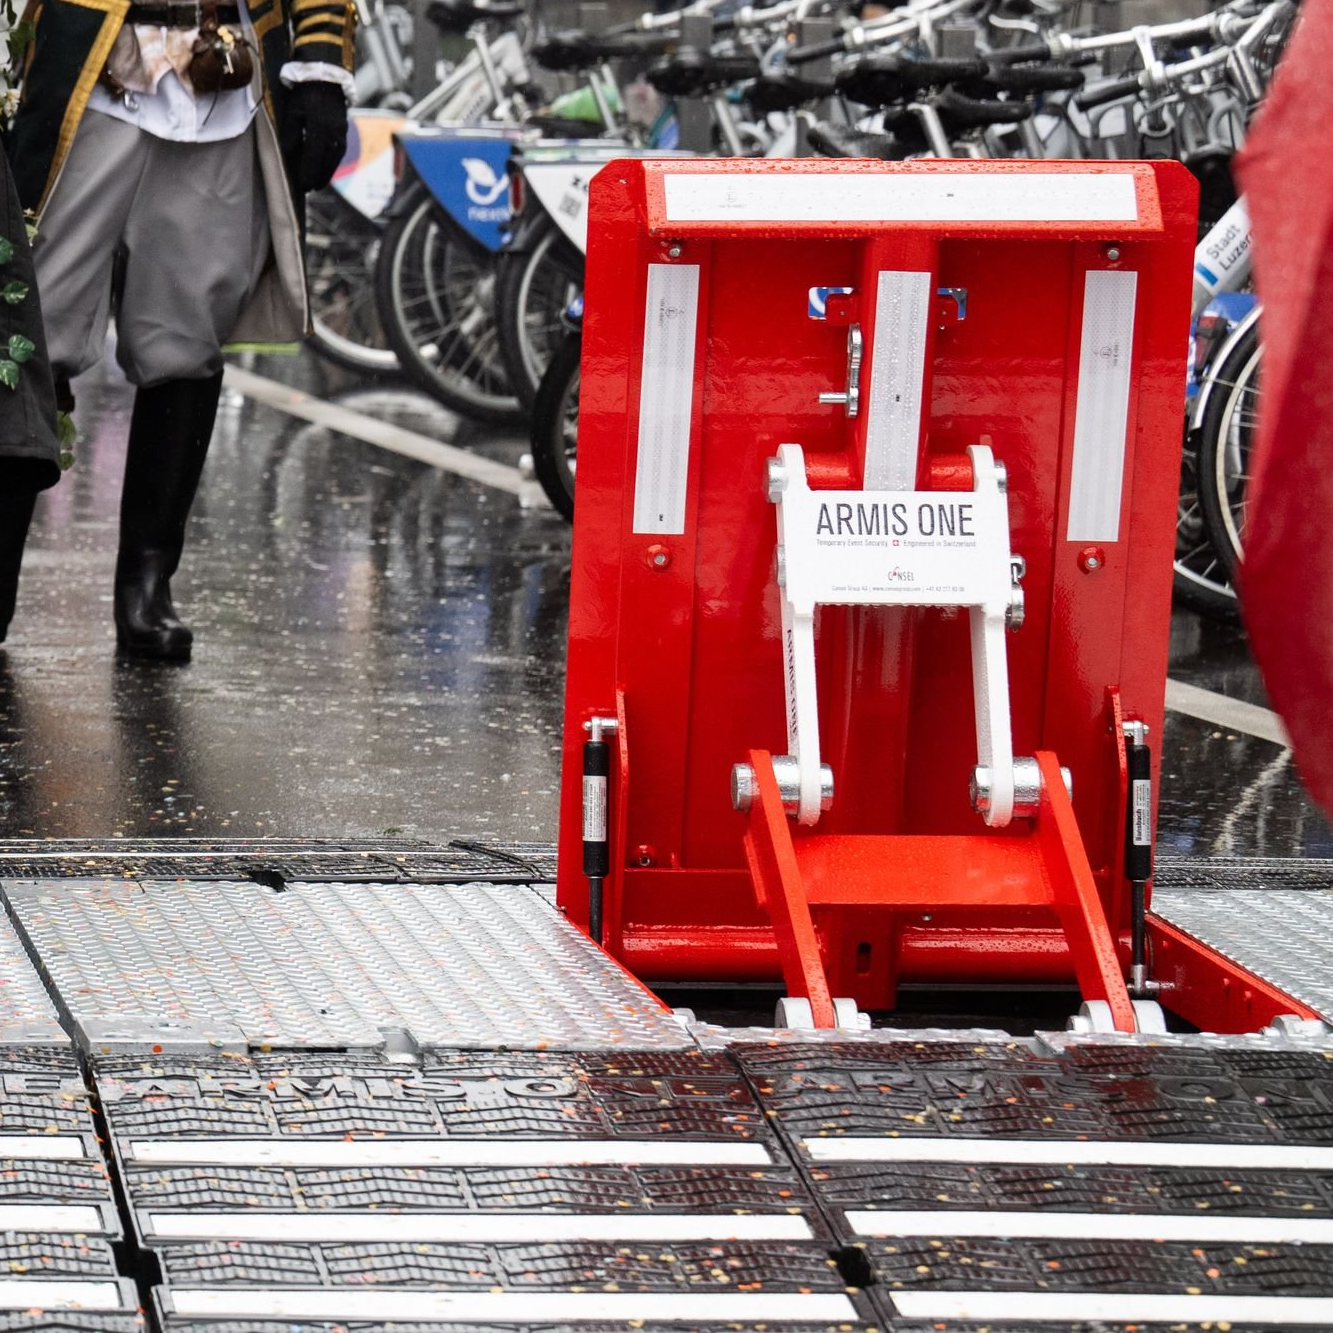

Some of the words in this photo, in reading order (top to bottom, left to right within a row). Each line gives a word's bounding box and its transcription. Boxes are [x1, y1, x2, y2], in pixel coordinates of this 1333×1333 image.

[1206, 224, 1241, 260] Stadt
[1218, 230, 1253, 271] Luzer
[816, 502, 908, 536] ARMIS
[917, 503, 975, 536] ONE
[816, 539, 846, 548] Temporary
[847, 539, 863, 547] Event
[864, 539, 888, 548] Security
[943, 540, 976, 548] Switzerland
